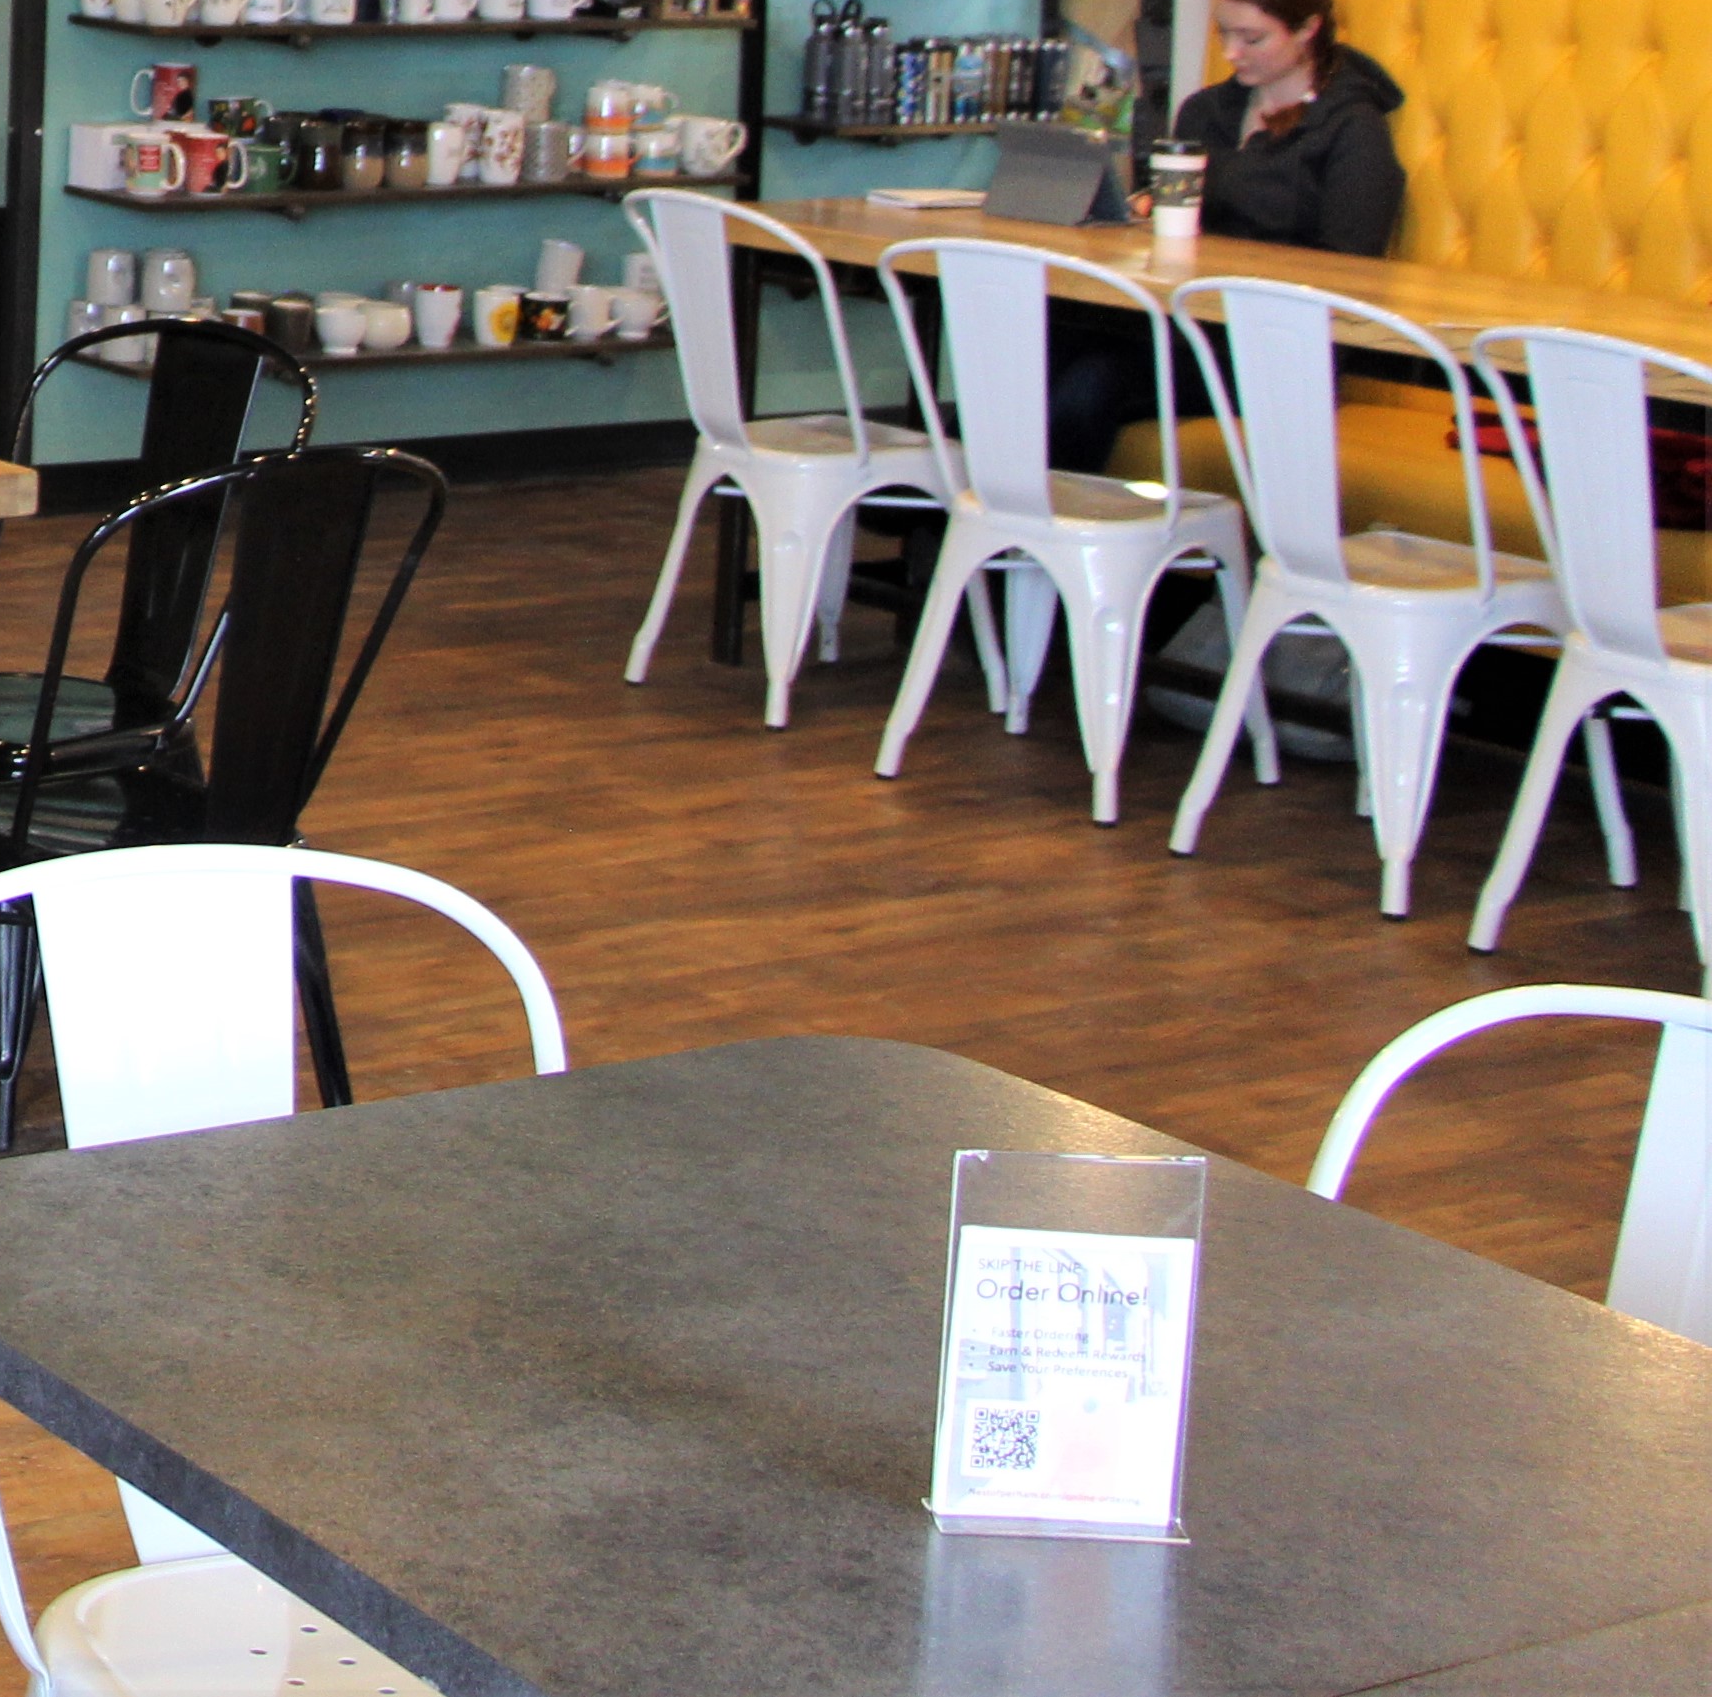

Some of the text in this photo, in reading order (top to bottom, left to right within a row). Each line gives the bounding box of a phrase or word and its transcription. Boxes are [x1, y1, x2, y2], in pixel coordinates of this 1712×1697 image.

[978, 1258, 1082, 1274] SKIP THE LINE
[977, 1278, 1148, 1306] Order Online!
[991, 1326, 1089, 1345] Faster Ordering
[989, 1344, 1146, 1363] Earn & Redeem Rewards
[987, 1361, 1128, 1379] Save Your Preferences
